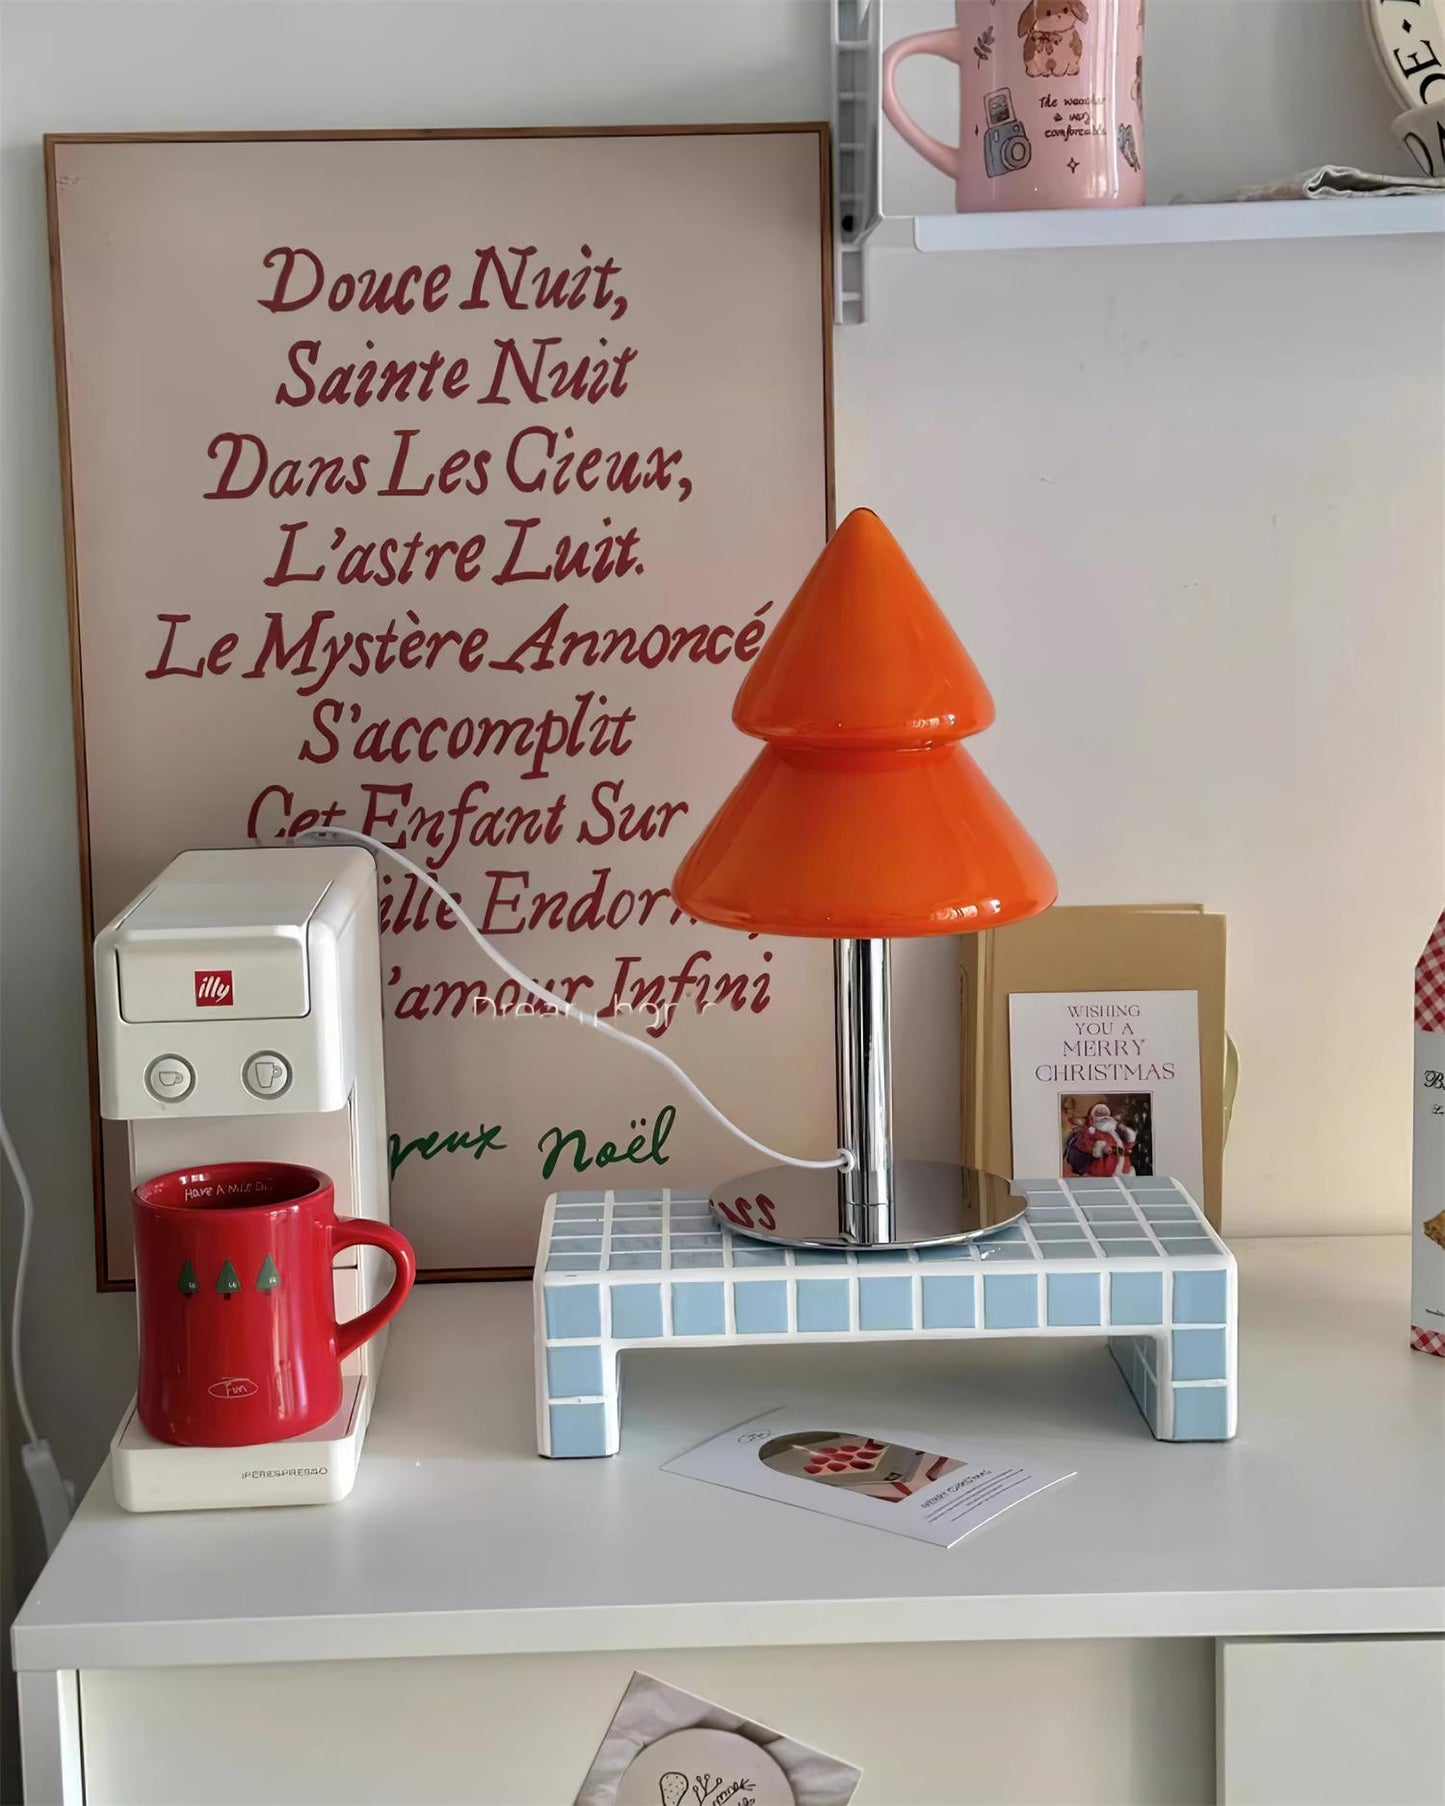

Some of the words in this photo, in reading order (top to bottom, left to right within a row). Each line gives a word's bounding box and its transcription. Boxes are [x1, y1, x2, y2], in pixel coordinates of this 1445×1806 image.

[258, 247, 451, 315] Douce
[461, 245, 629, 320] Nuit,
[275, 340, 470, 407] Sainte
[477, 337, 638, 405] Nuit
[203, 432, 369, 500] Dans
[378, 429, 491, 497] Les
[506, 425, 693, 502] Cieux,
[263, 521, 486, 587] L'astre
[491, 517, 645, 586] Luit.
[145, 613, 239, 679] Le
[242, 610, 489, 697] Mystère
[489, 601, 774, 672] Annoncé
[298, 691, 636, 780] S'accomplit
[361, 780, 566, 871] Enfant
[577, 779, 690, 846] Sur
[380, 873, 461, 935] ille
[198, 975, 231, 1003] illy
[387, 965, 595, 1020] 'amour
[597, 950, 774, 1039] Infini
[1068, 1004, 1141, 1018] WISHING
[1063, 1039, 1146, 1057] MERRY
[1075, 1022, 1114, 1035] YOU
[1121, 1022, 1134, 1035] A
[1034, 1062, 1176, 1082] CHRISTMAS
[386, 1122, 508, 1182] yeux
